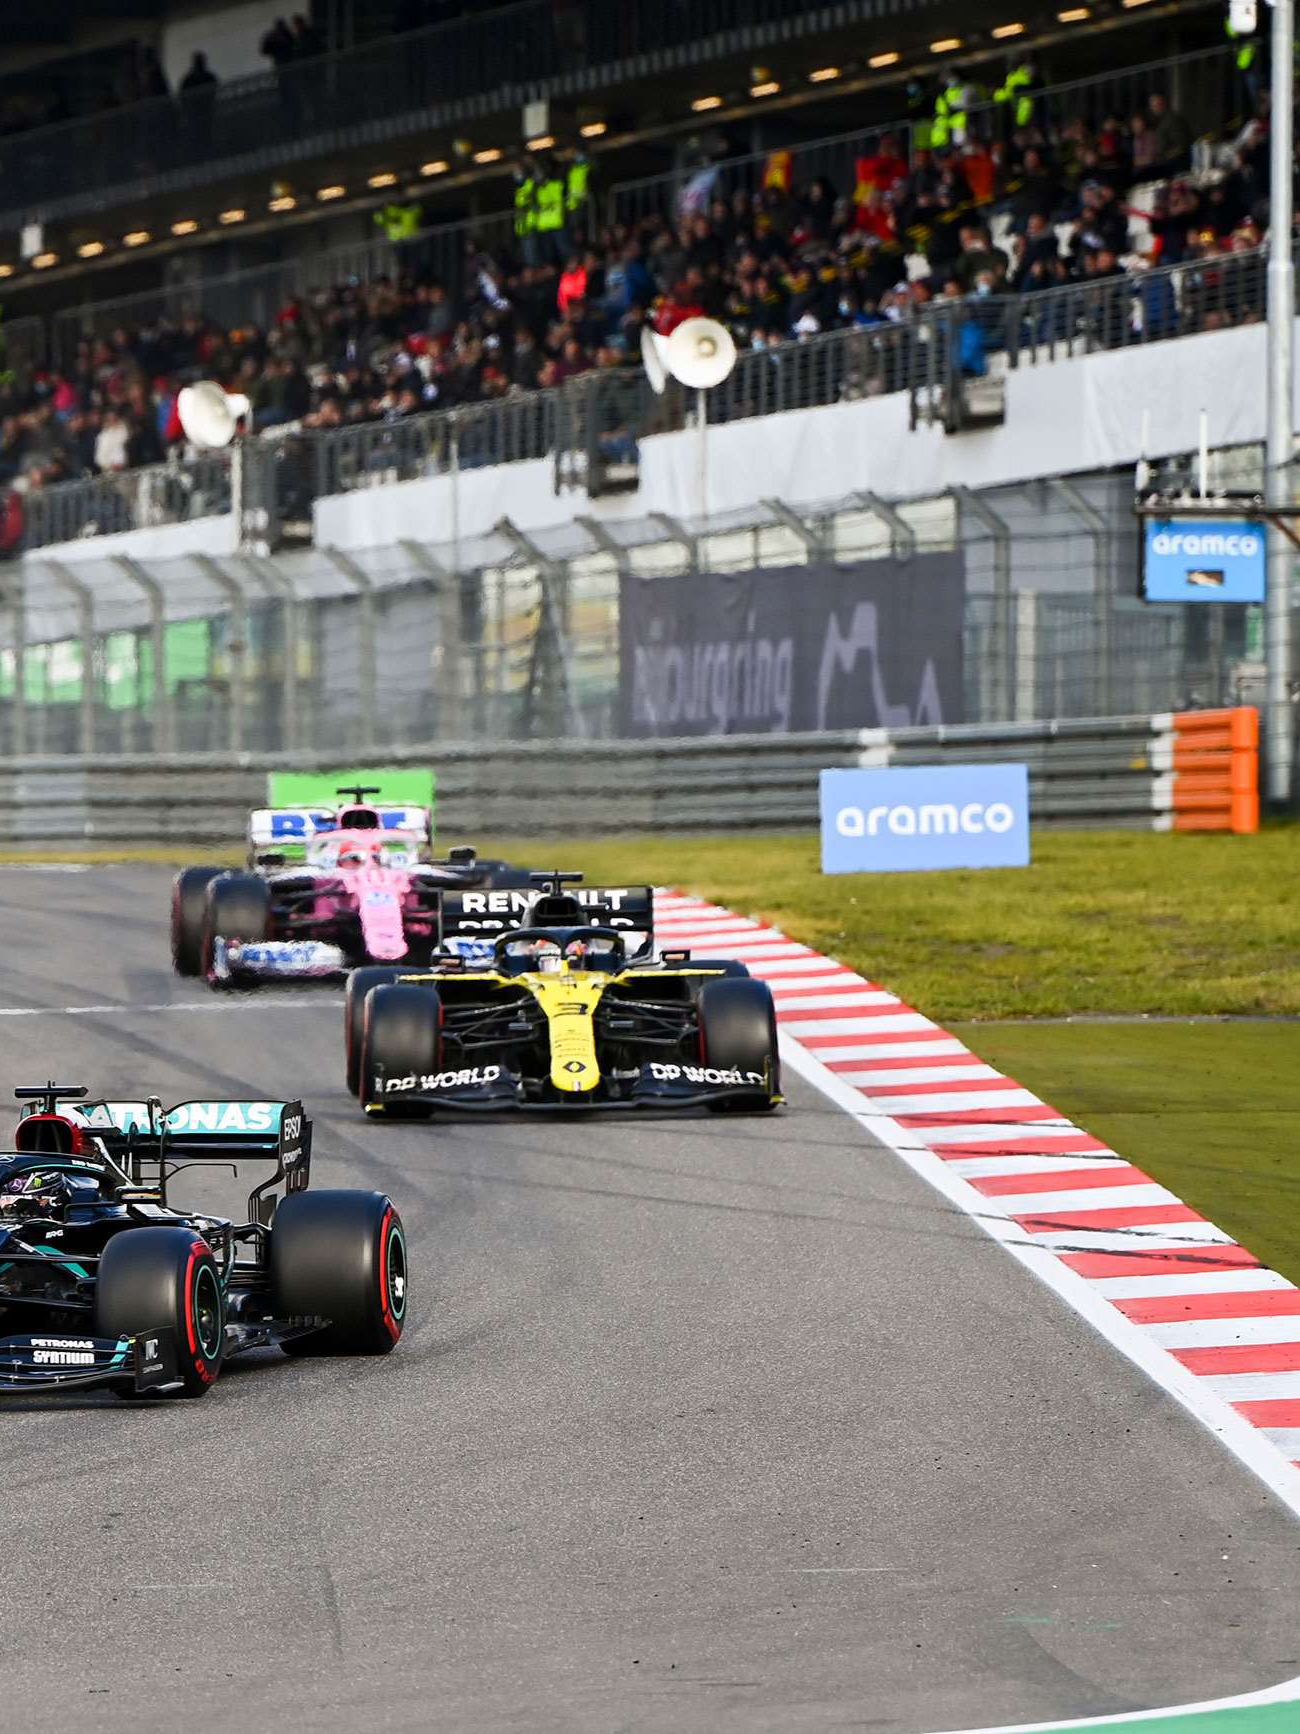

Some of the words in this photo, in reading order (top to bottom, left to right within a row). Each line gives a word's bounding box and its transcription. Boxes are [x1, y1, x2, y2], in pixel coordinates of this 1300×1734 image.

[1152, 534, 1258, 555] aramco
[836, 803, 1015, 837] aramco
[461, 889, 629, 913] RENLT
[385, 1076, 416, 1092] DP
[420, 1065, 501, 1090] WORLD
[649, 1062, 681, 1080] DP
[86, 1103, 273, 1131] TRONAS
[30, 1338, 95, 1349] PETRONAS
